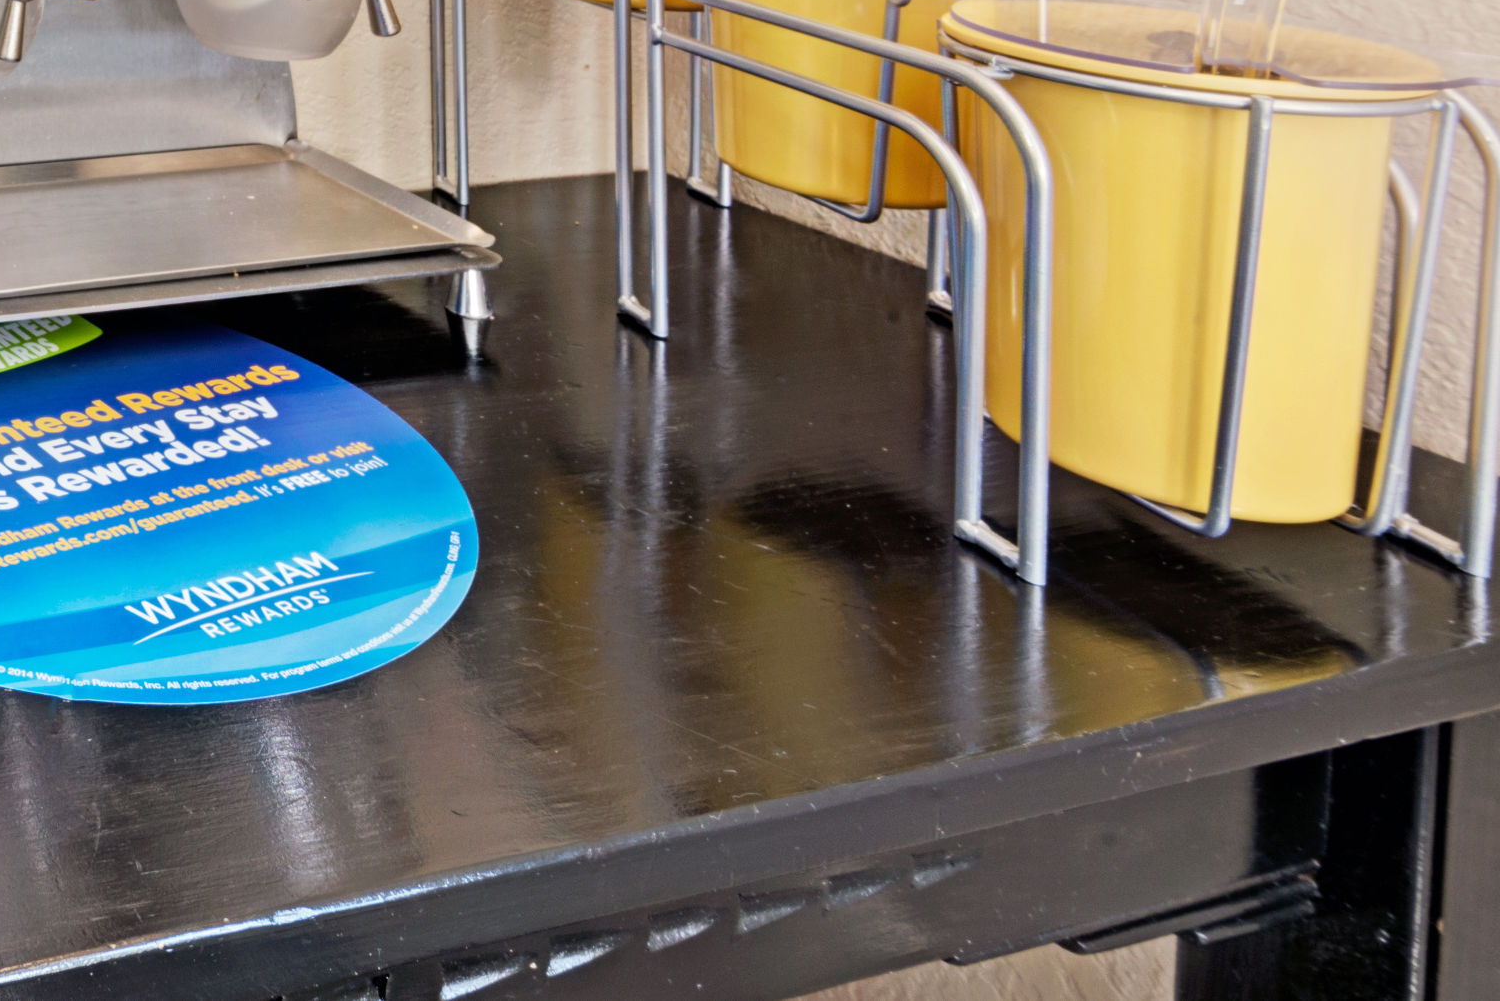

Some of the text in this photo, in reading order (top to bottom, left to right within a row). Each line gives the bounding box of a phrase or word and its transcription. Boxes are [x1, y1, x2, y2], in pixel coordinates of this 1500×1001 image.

[116, 364, 300, 414] Rewards
[38, 420, 176, 463] Every
[174, 396, 278, 430] Stay
[16, 426, 271, 502] Rewarded!
[56, 495, 150, 530] Rewards
[149, 491, 176, 506] at
[172, 482, 210, 499] the
[208, 470, 262, 490] front
[260, 455, 309, 478] desk
[307, 451, 331, 465] or
[328, 440, 375, 459] visit
[278, 470, 332, 491] FREE
[330, 466, 350, 480] to
[349, 455, 389, 477] join!
[124, 551, 340, 625] WYNDHAM
[7, 667, 34, 679] 2014
[166, 681, 181, 689] All
[182, 680, 212, 691] rights
[213, 674, 260, 687] reserved.
[261, 671, 280, 681] For
[279, 662, 319, 679] program
[315, 654, 343, 668] terms
[341, 648, 359, 660] and
